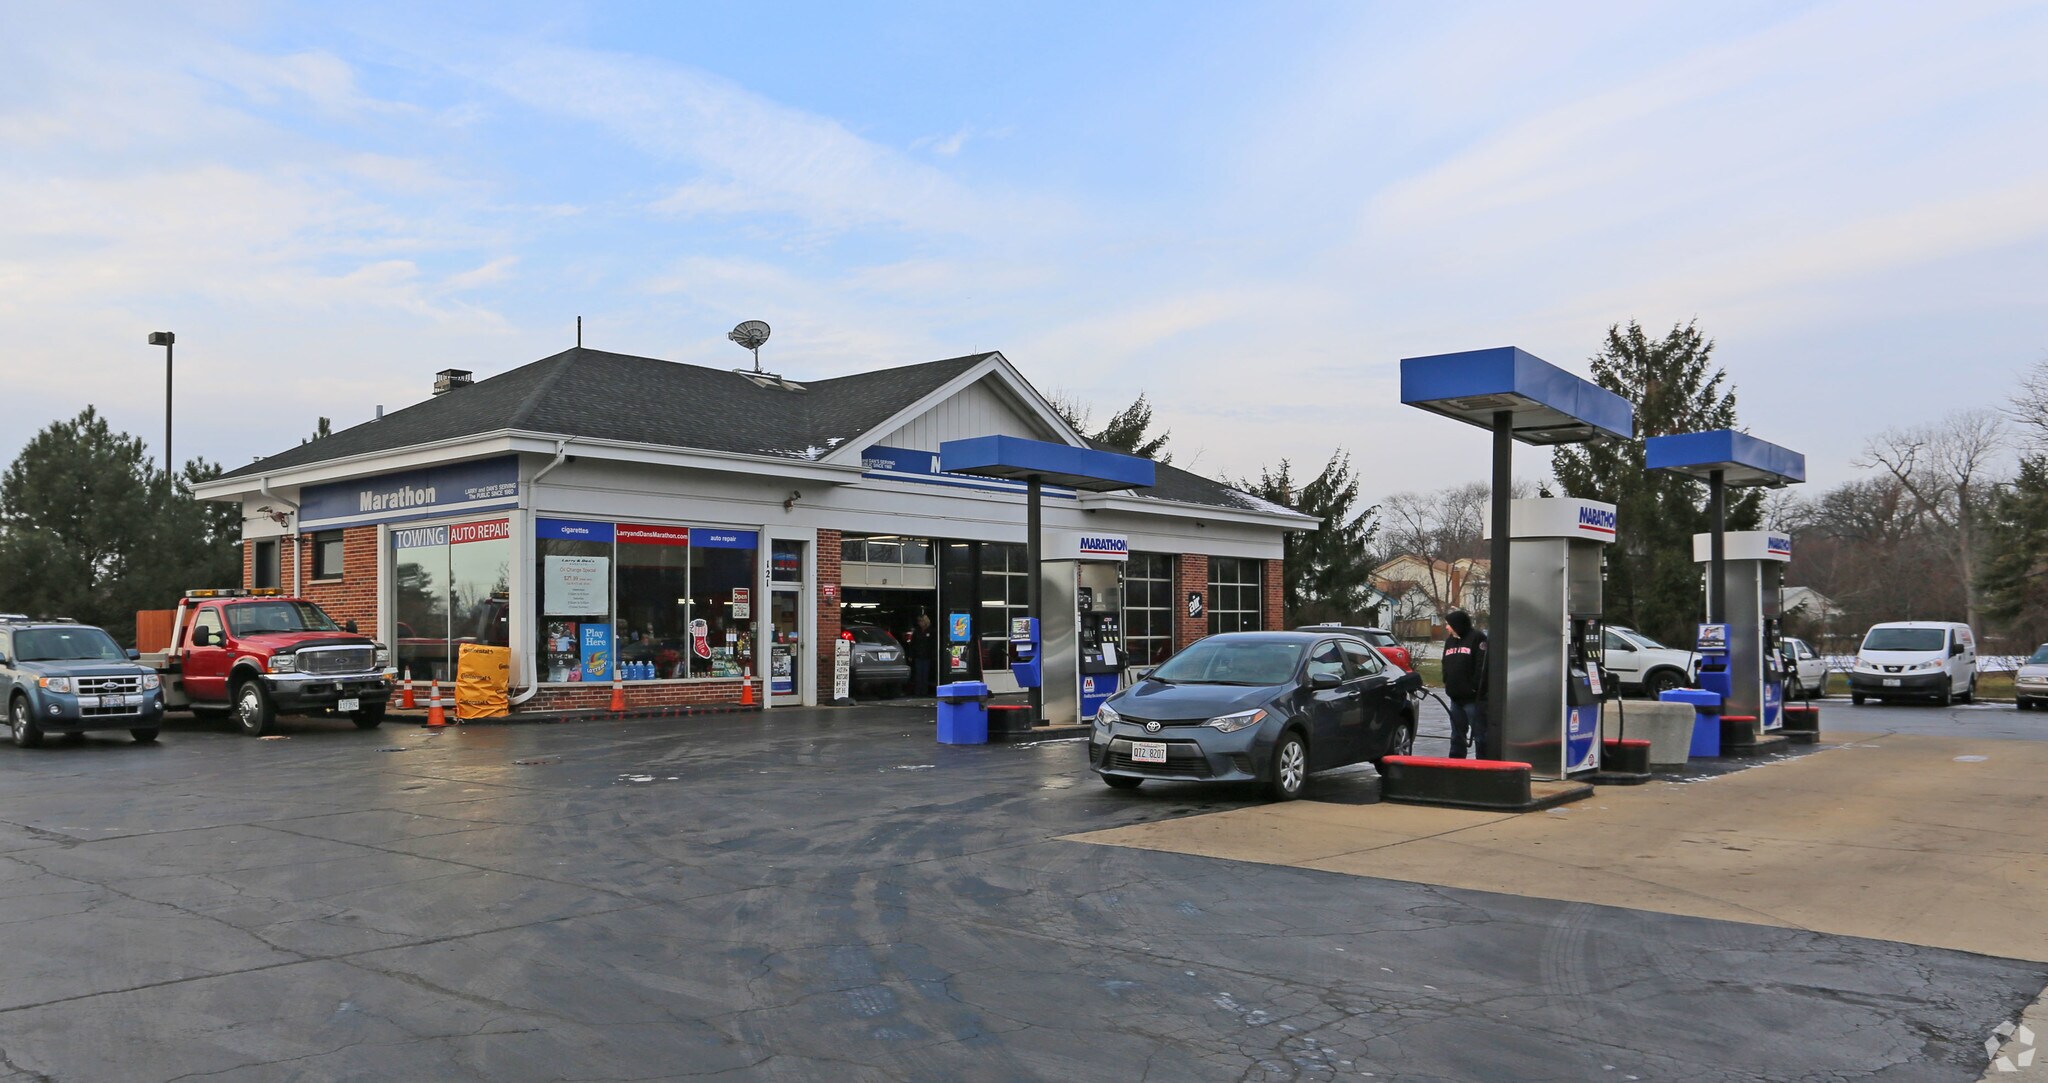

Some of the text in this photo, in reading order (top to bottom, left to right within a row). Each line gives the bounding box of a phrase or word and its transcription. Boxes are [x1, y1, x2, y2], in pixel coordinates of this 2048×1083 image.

[486, 484, 498, 492] DAN'S
[499, 482, 517, 490] SERVING
[360, 485, 436, 511] Marathon
[476, 491, 491, 499] PUBLIC
[491, 489, 503, 497] SINCE
[451, 522, 509, 542] AUTO REPAIR
[561, 526, 589, 535] cigarettes
[616, 529, 688, 540] LarryandDansMarathon.com
[396, 527, 444, 548] TOWING
[1080, 537, 1128, 551] MARATHON
[1188, 595, 1200, 613] air
[585, 628, 604, 639] Play
[585, 638, 606, 646] Here
[586, 660, 608, 673] LOTTERY
[1149, 749, 1165, 759] 8207
